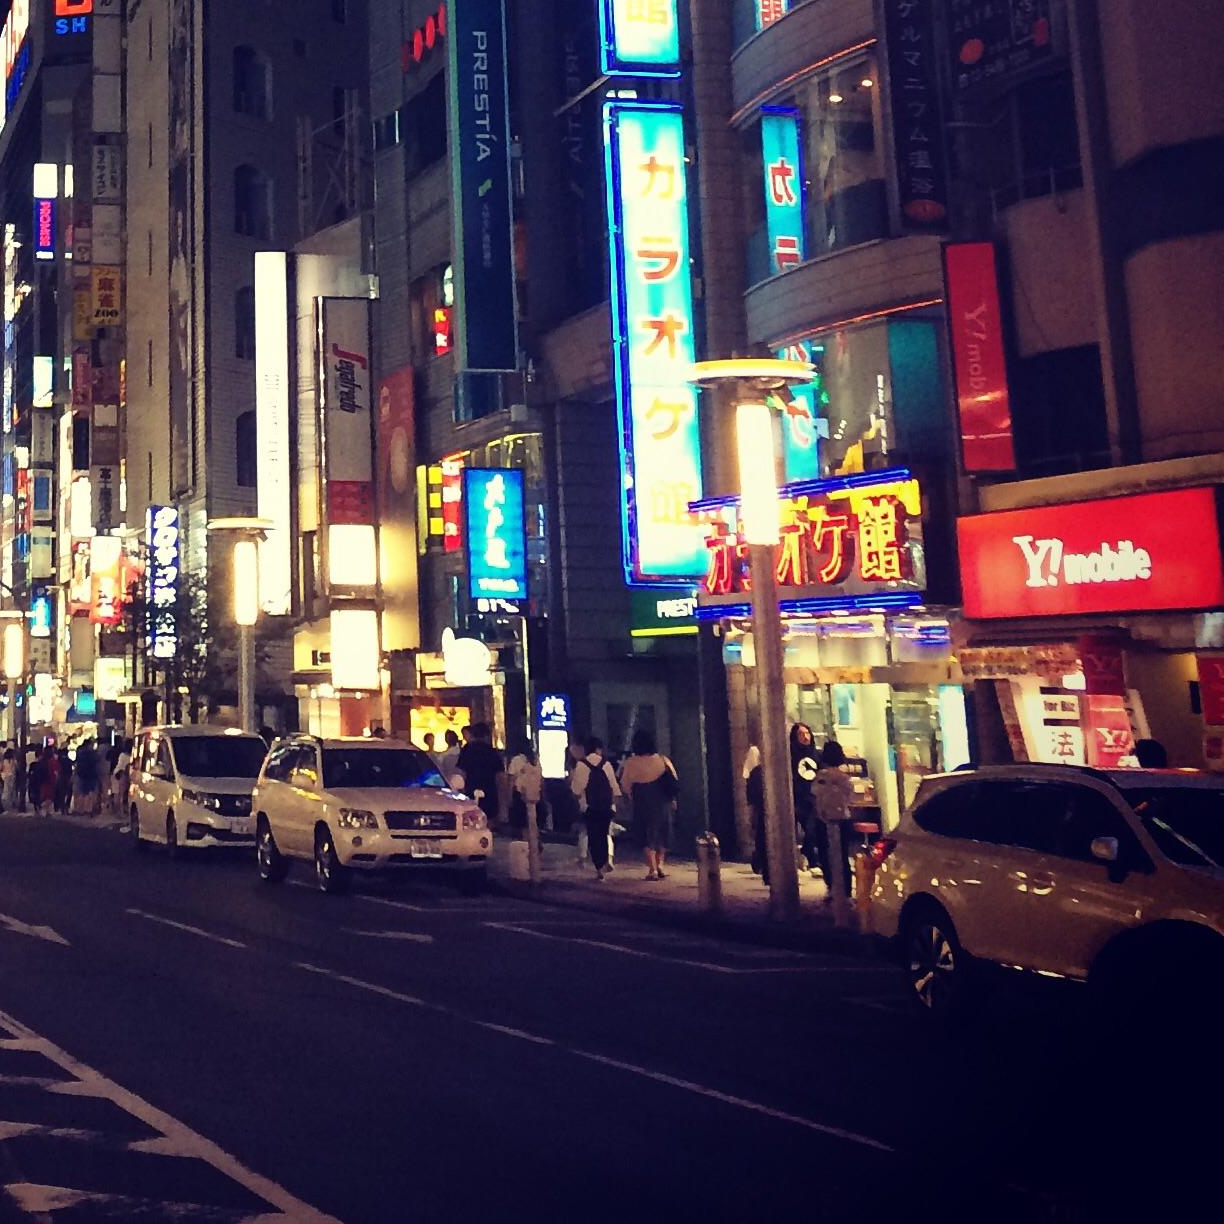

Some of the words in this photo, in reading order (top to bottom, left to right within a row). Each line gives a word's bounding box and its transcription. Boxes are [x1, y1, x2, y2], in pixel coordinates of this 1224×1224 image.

[332, 342, 368, 414] Segafredo
[633, 153, 697, 527] カラオケ館
[703, 495, 903, 596] カオケ館
[1050, 731, 1076, 765] 法
